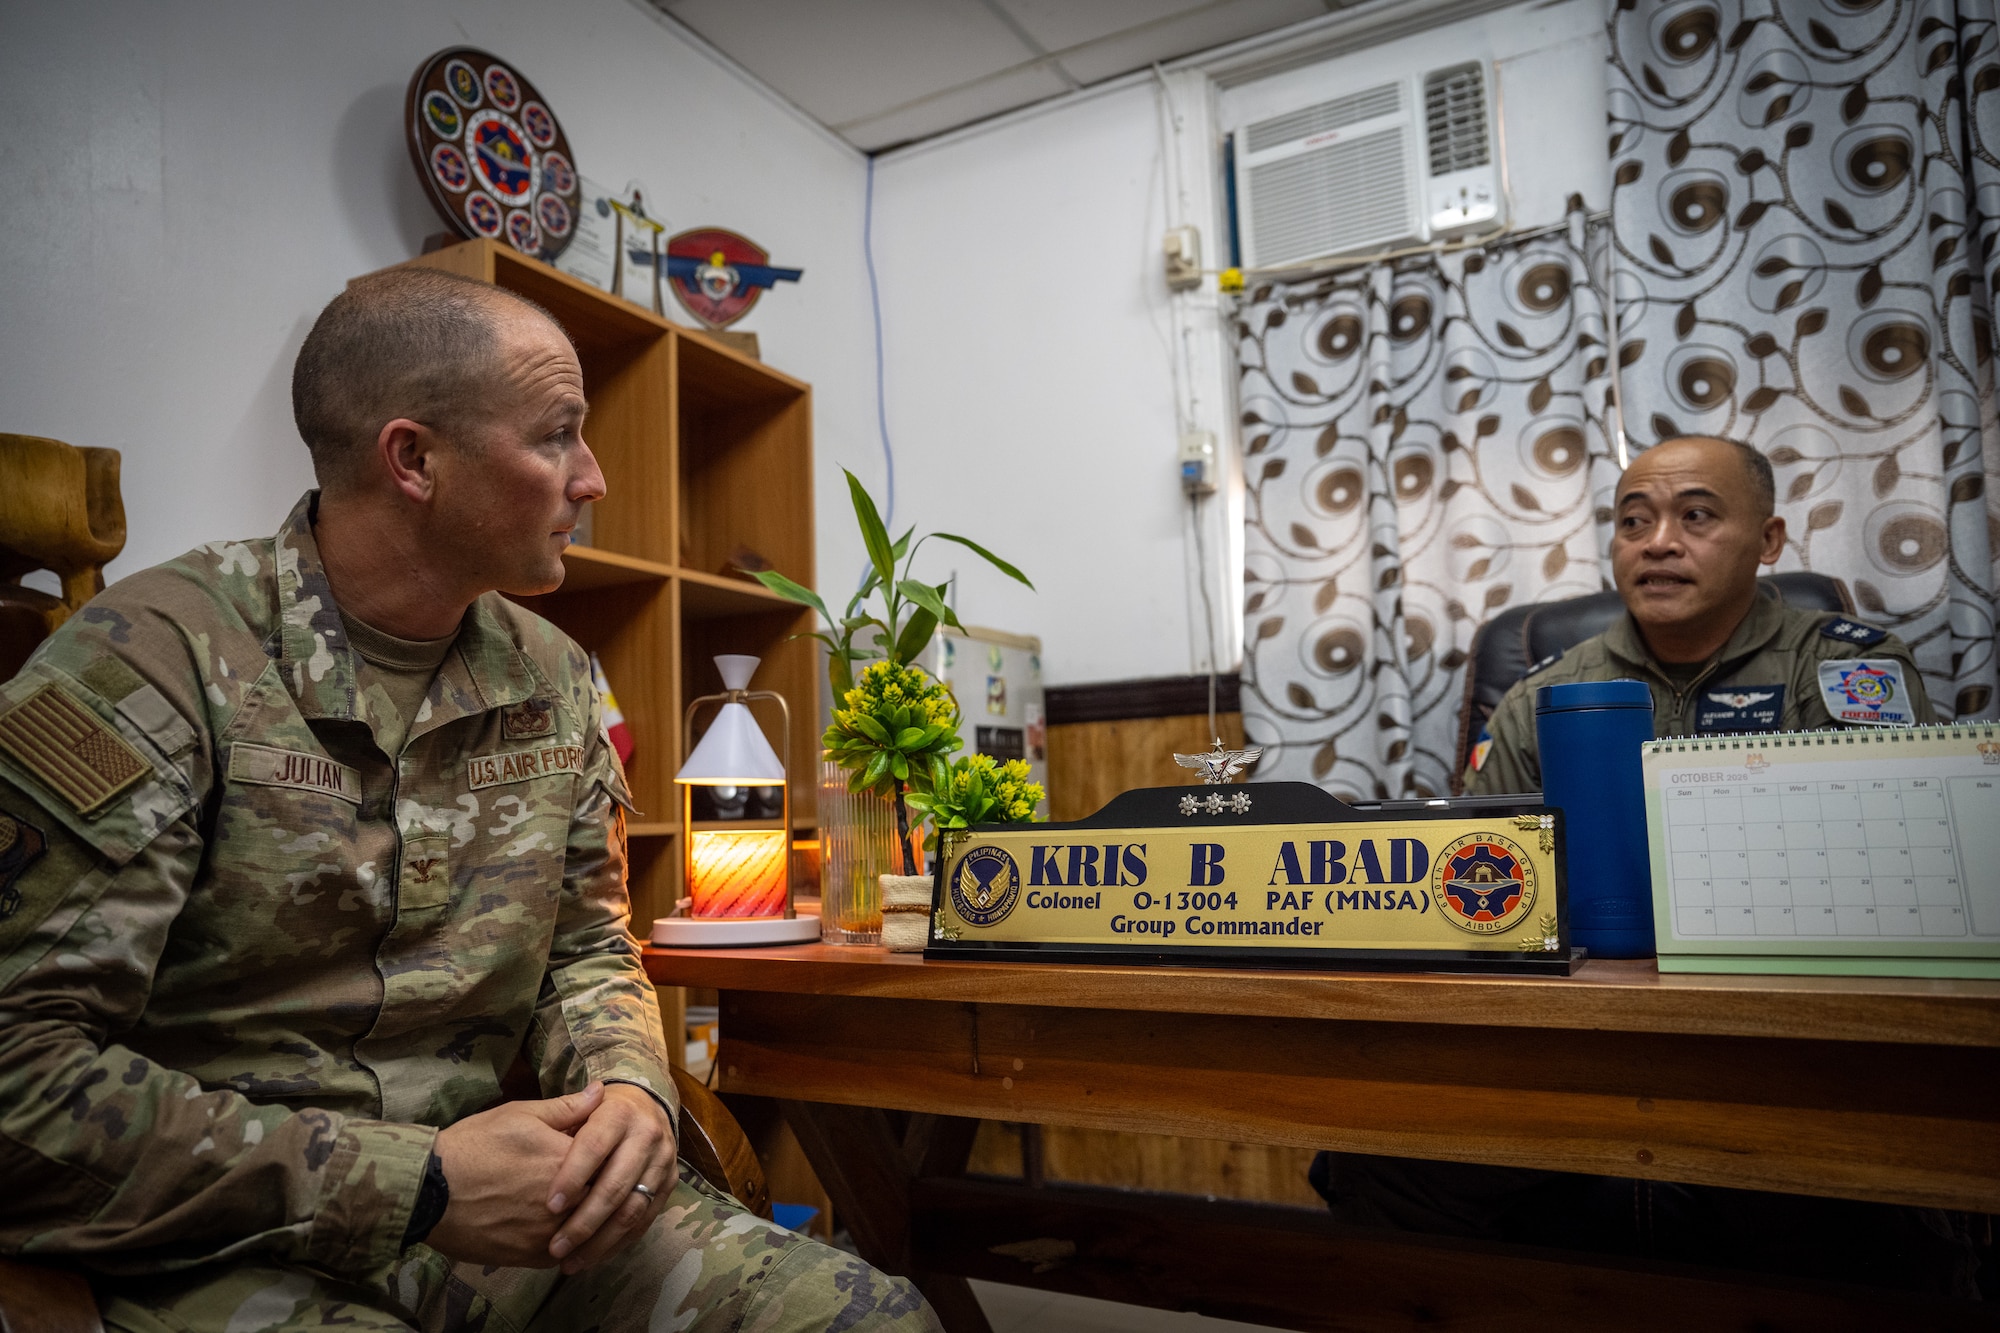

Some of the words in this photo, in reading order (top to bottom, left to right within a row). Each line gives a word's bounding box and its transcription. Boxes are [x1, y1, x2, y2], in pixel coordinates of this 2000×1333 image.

[275, 755, 342, 791] JULIAN
[503, 753, 538, 781] AIR
[541, 746, 584, 772] FORC
[1671, 772, 1724, 784] OCTOBER
[1913, 780, 1927, 788] Sat
[968, 847, 1008, 861] PILIPINAS
[1027, 843, 1149, 887] KRIS
[1187, 843, 1226, 887] B
[1267, 838, 1430, 886] ABAD
[1434, 867, 1448, 908] 600th
[1444, 840, 1466, 859] AIR
[1475, 835, 1515, 852] BASE
[1519, 857, 1534, 910] GROUP
[952, 886, 976, 921] HUKBONG
[1026, 891, 1101, 909] Colonel
[1133, 891, 1238, 911] O-13004
[1266, 891, 1314, 911] PAF
[1324, 890, 1430, 914] (MNSA)
[1110, 914, 1176, 938] Group
[1185, 916, 1324, 936] Commander
[1465, 921, 1501, 931] AIBDC
